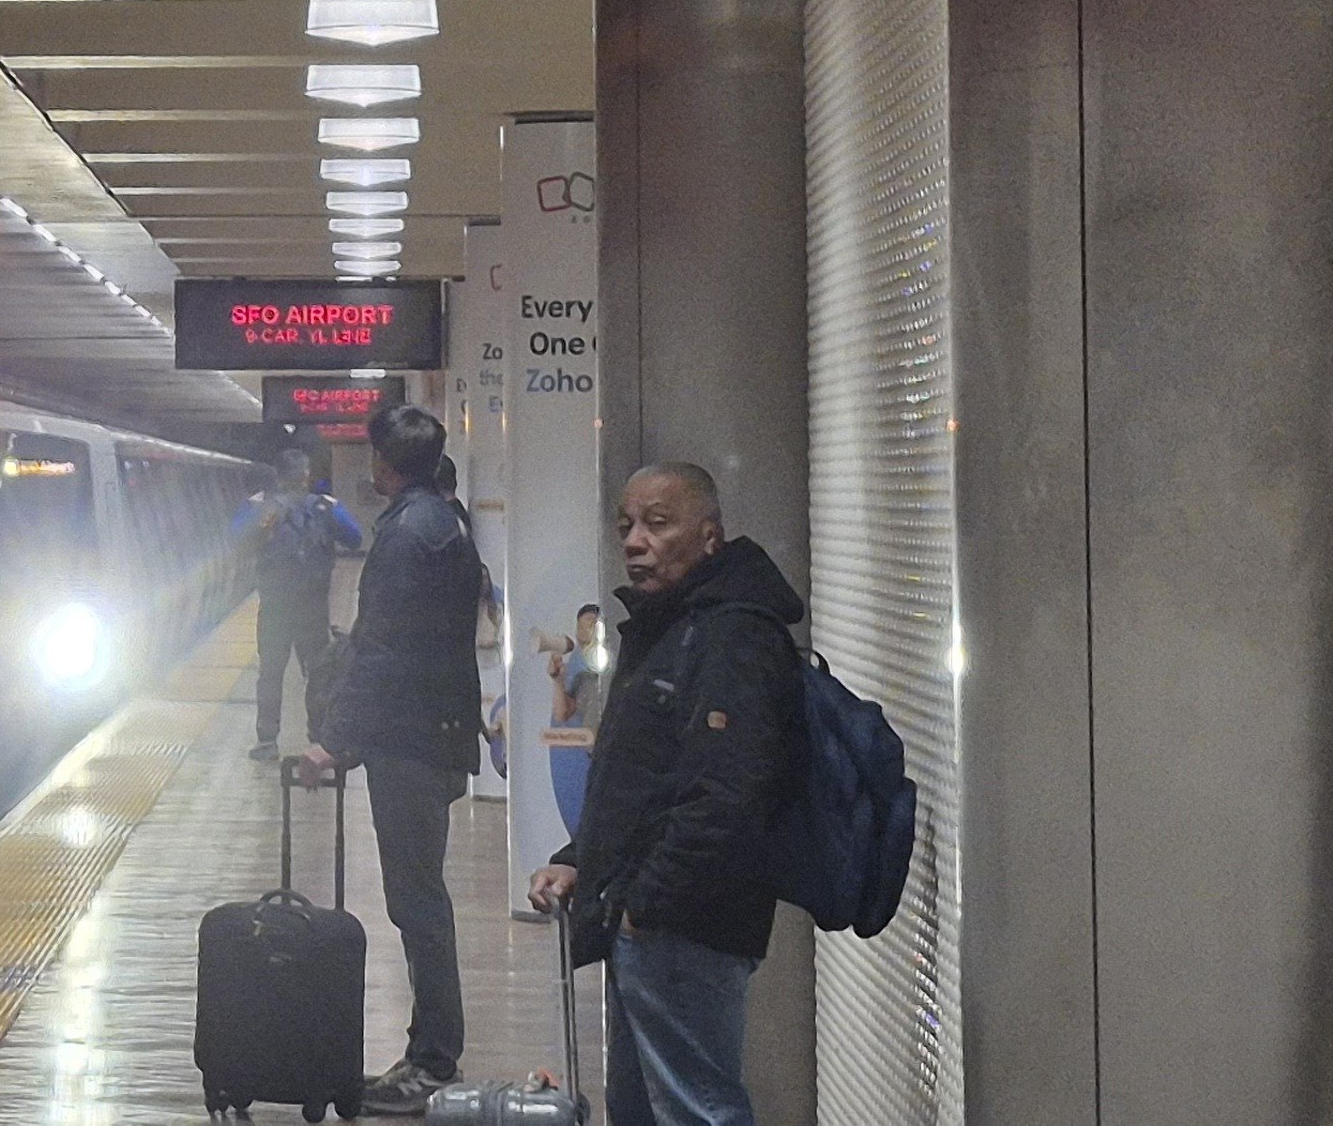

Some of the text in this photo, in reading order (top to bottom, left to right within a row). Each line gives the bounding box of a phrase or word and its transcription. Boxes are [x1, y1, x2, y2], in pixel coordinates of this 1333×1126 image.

[231, 303, 394, 325] SFO AIRPORT
[521, 295, 594, 323] Every
[529, 331, 586, 356] One
[525, 368, 594, 393] Zoho
